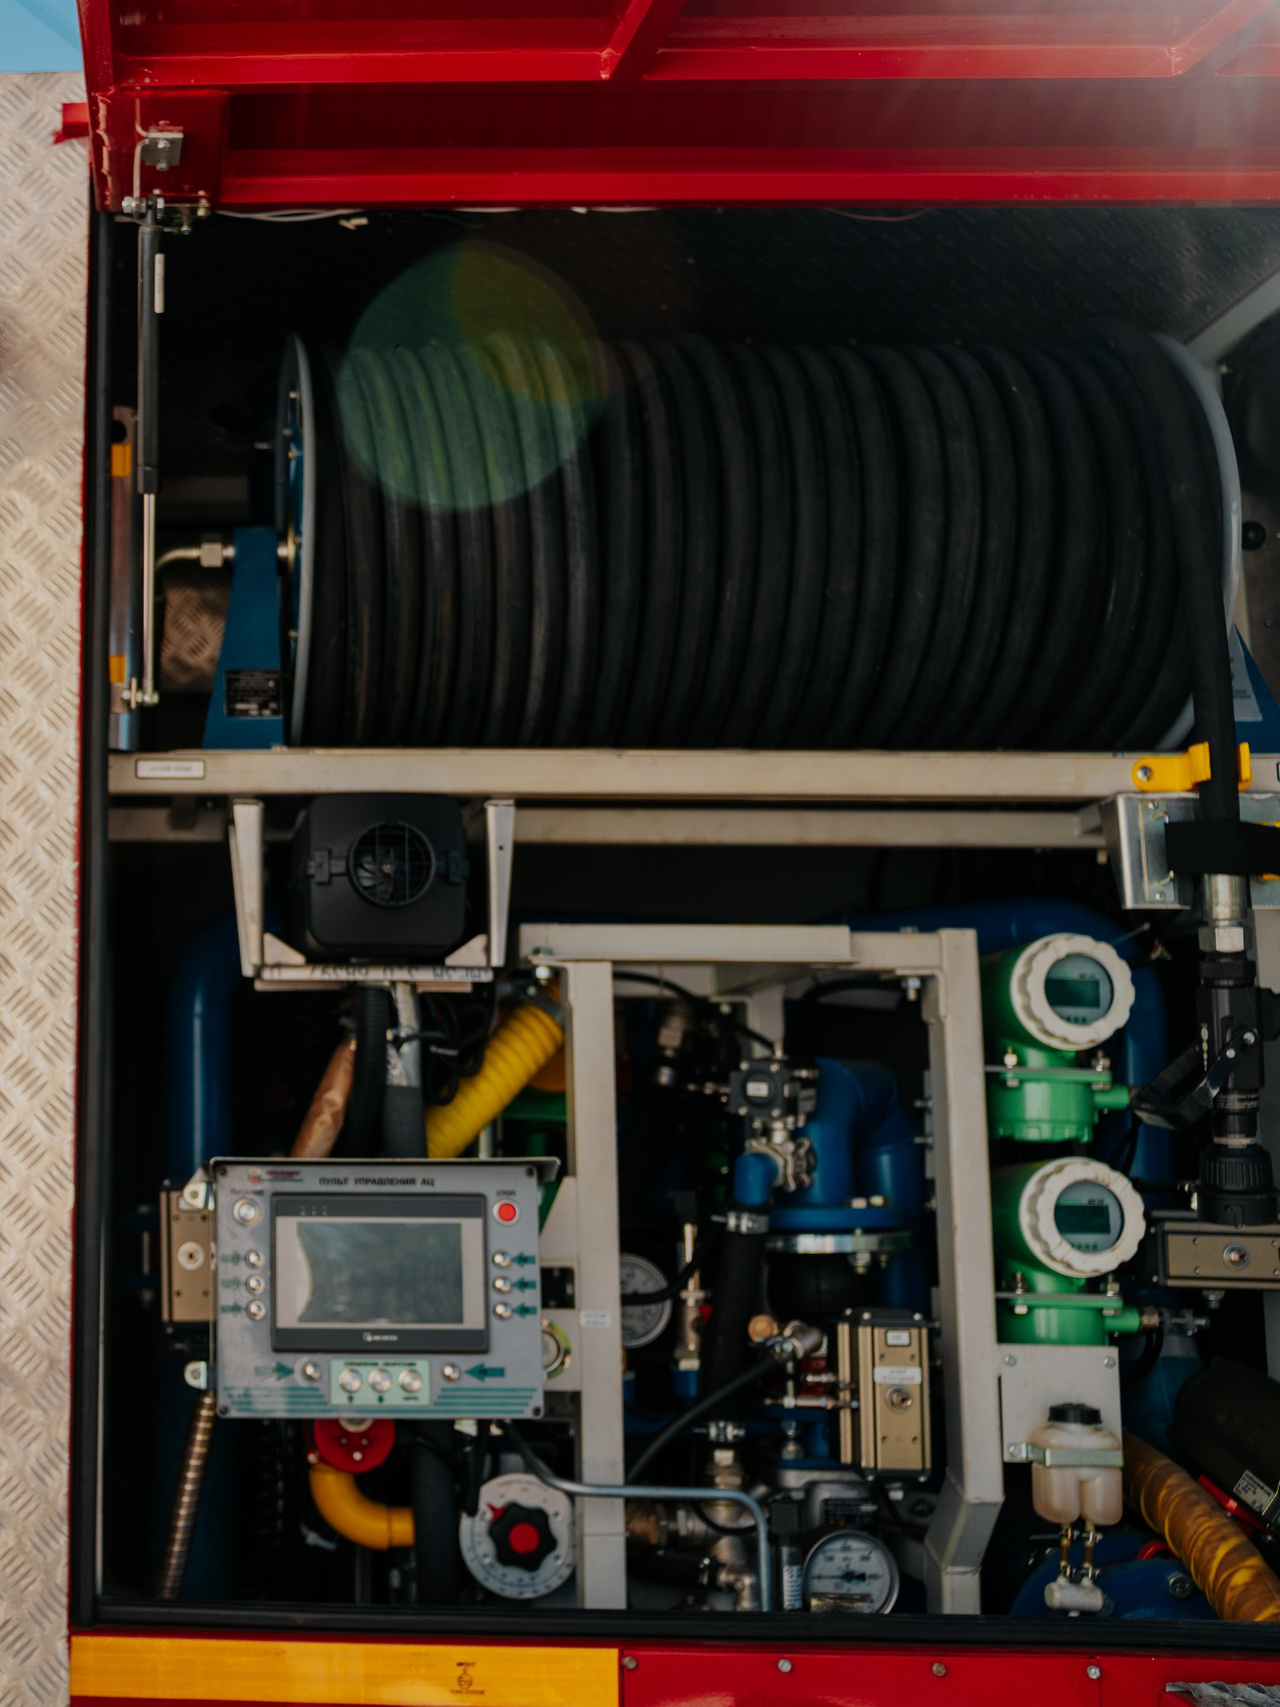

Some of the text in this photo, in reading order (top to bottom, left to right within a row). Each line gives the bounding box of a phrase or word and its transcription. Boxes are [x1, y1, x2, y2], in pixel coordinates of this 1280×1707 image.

[319, 1177, 435, 1187] ПУЛЬТ УПРАВЛЕНИЯ АЦ
